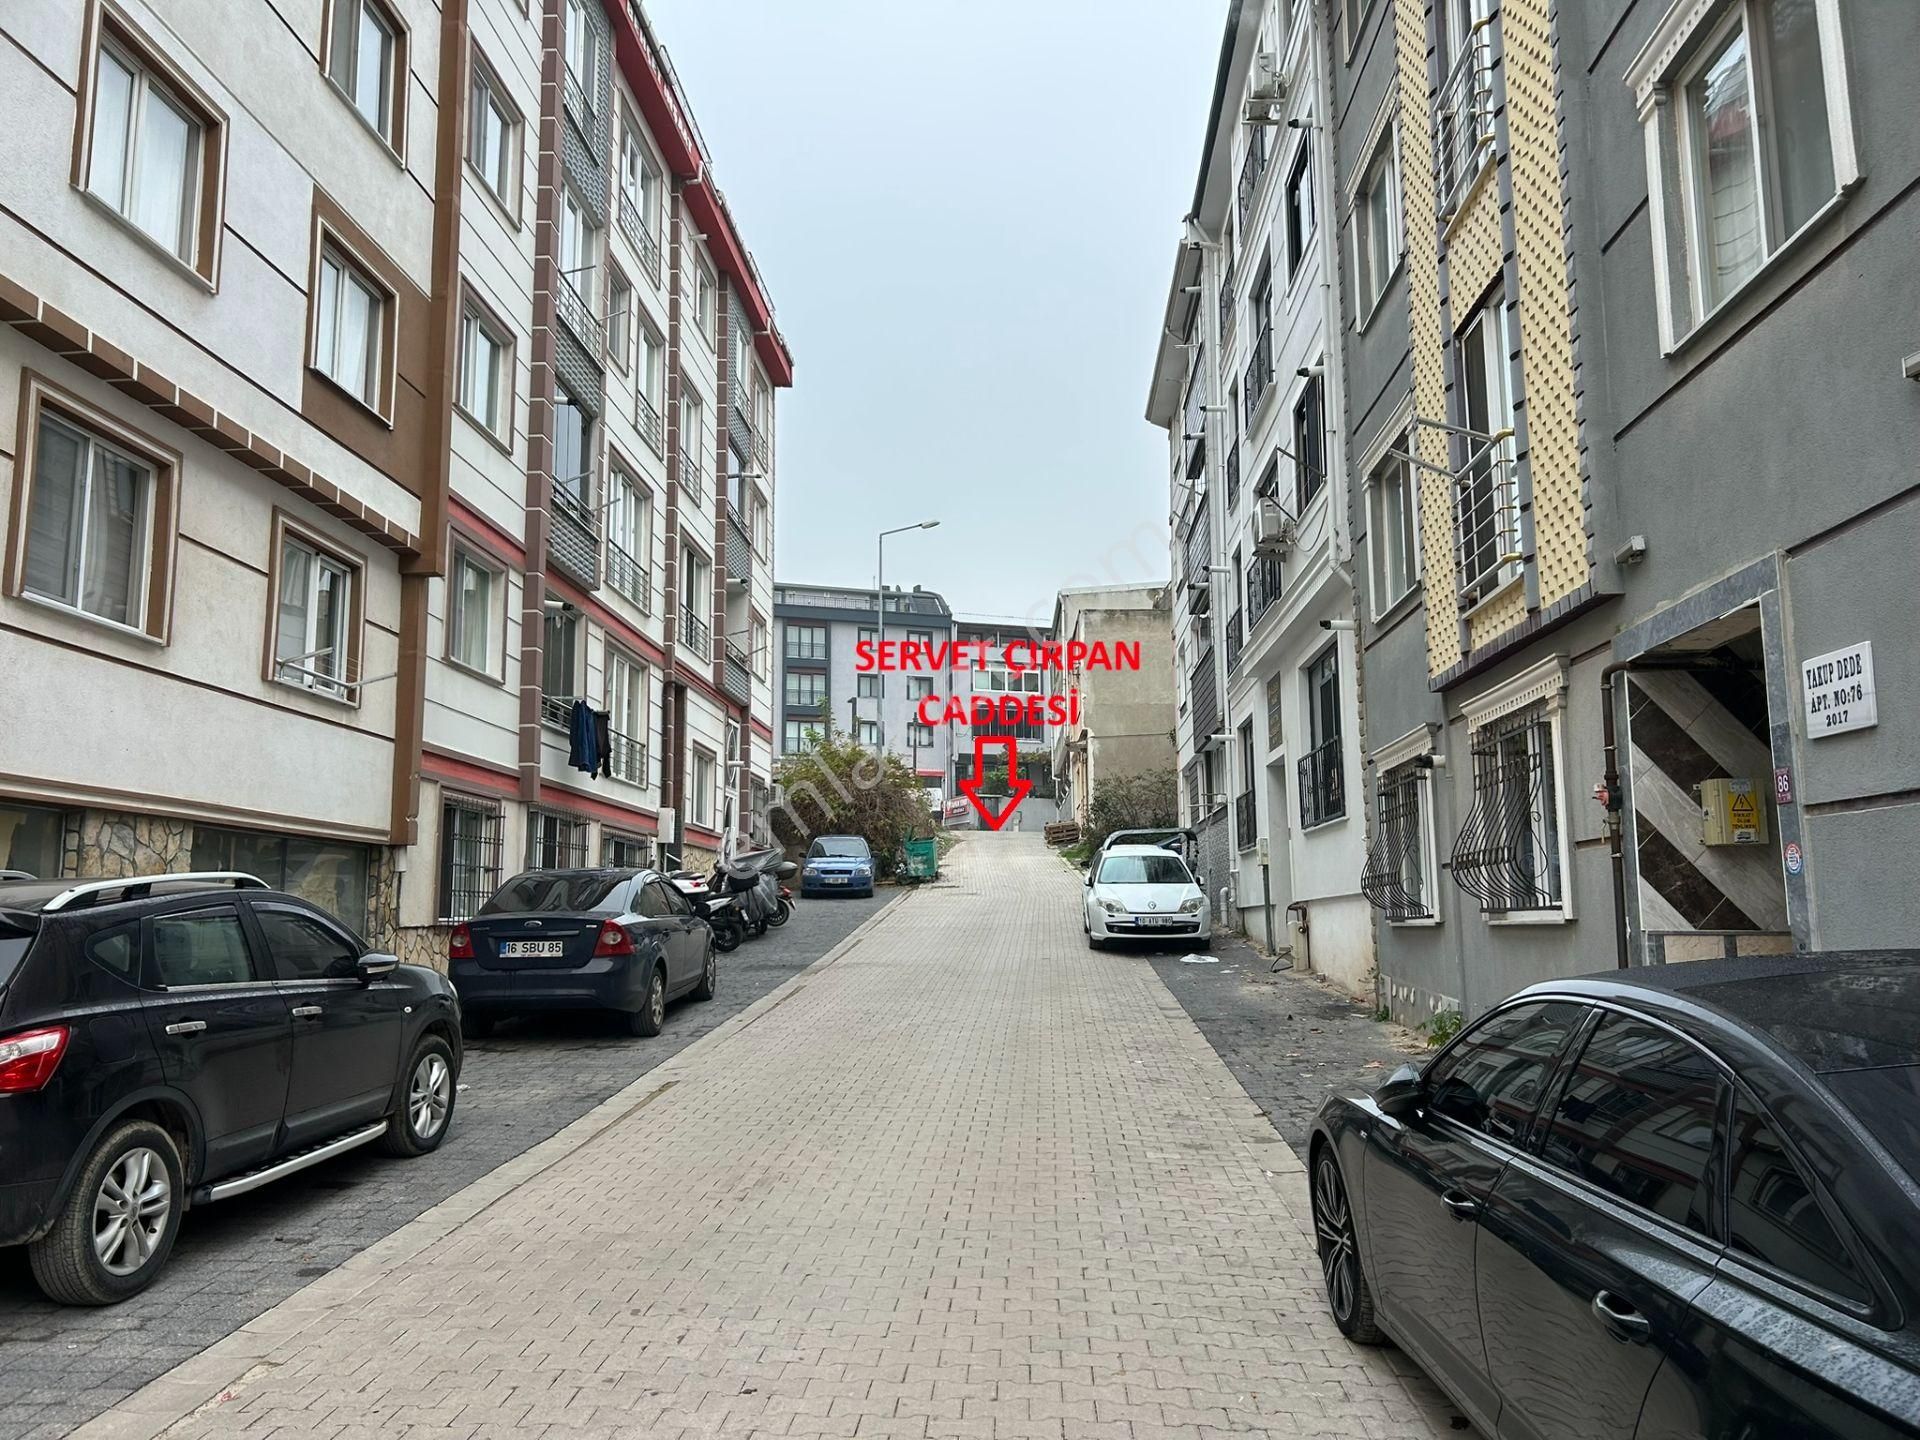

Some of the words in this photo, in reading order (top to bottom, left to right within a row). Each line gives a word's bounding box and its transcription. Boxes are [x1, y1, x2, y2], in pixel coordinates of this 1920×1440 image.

[1806, 662, 1833, 690] YAKUP
[1836, 653, 1862, 681] DEDE
[1833, 683, 1863, 708] NO:76
[1826, 710, 1849, 727] 2017
[1777, 775, 1789, 793] 86
[507, 942, 518, 954] 16
[521, 942, 545, 954] SBU
[548, 942, 561, 953] 85
